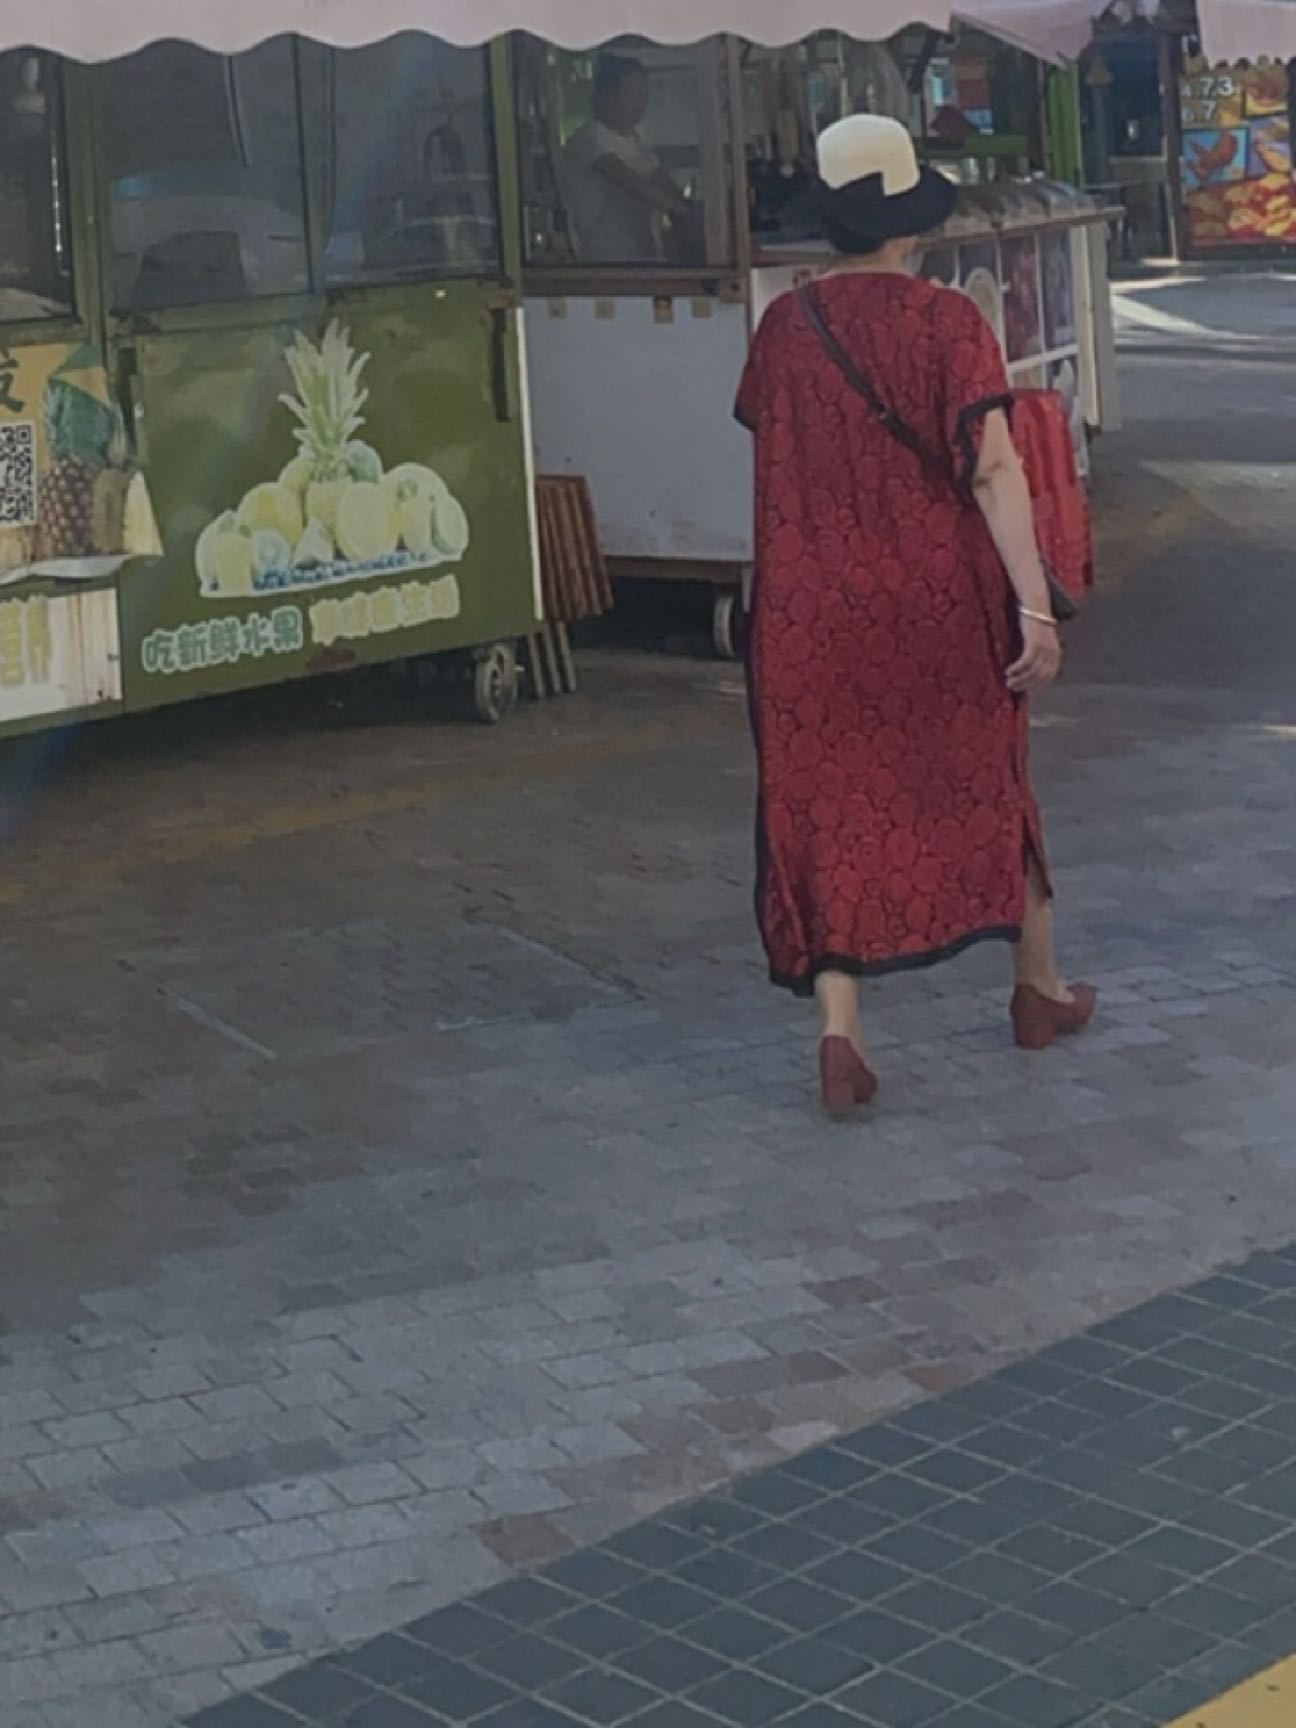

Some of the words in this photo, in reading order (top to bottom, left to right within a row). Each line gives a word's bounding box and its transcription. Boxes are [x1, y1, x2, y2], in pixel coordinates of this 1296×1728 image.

[142, 606, 304, 674] 吃新鲜水果
